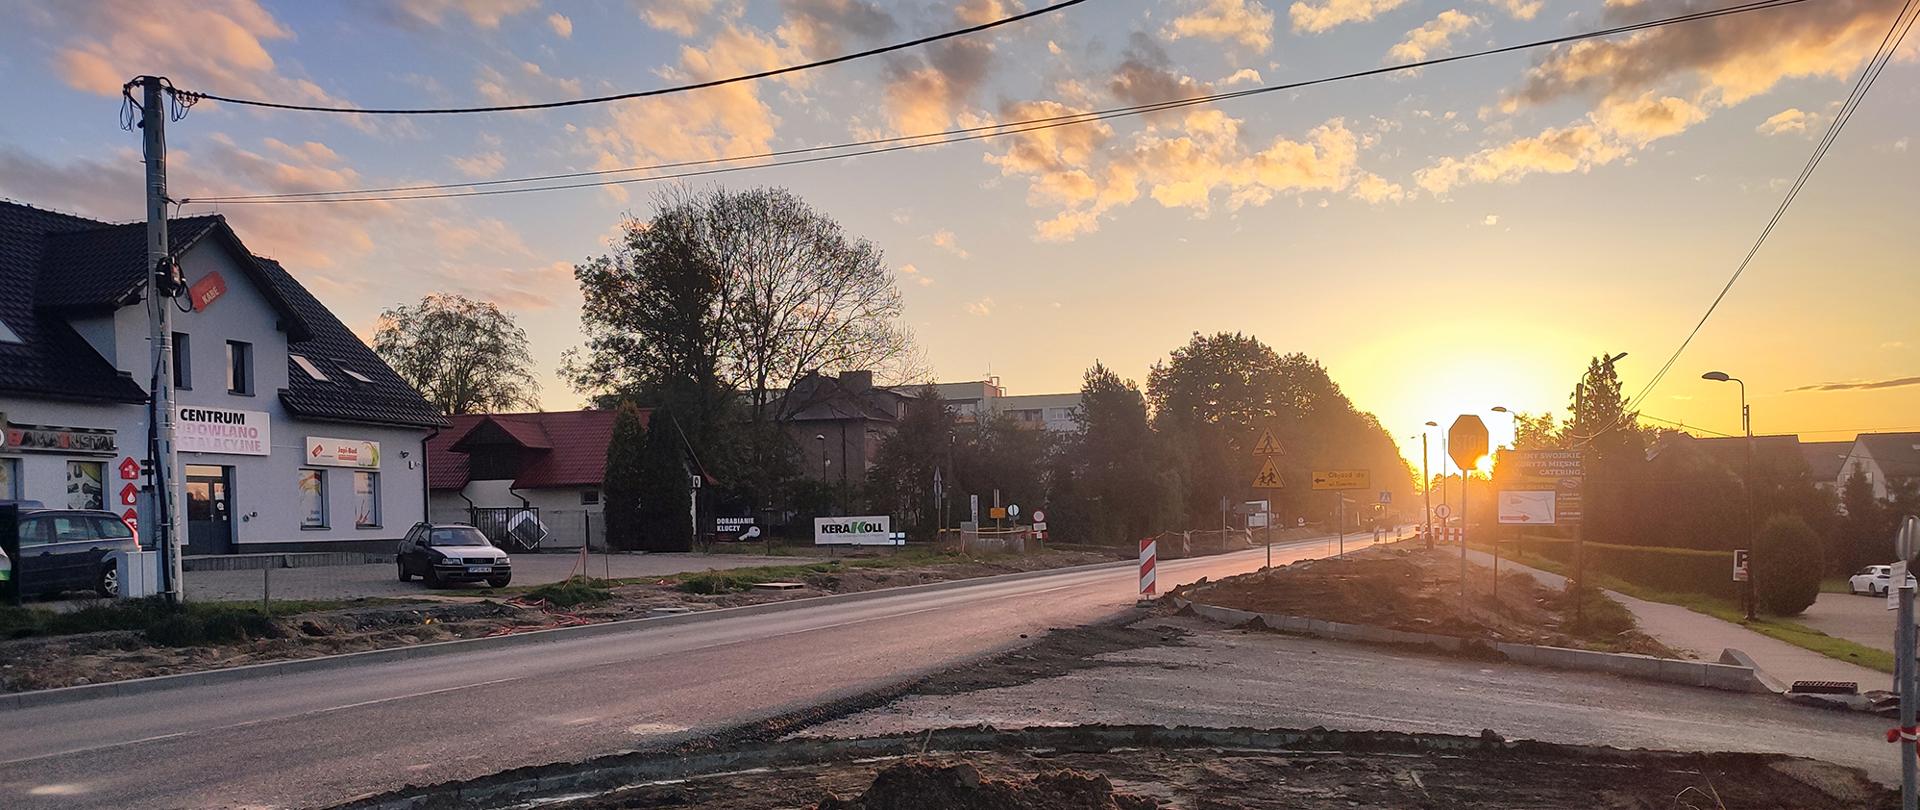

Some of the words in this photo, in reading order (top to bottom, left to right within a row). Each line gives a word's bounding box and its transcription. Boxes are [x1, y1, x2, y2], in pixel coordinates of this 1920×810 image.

[201, 286, 220, 305] KABE
[180, 408, 245, 425] CENTRUM
[716, 517, 754, 525] DORABIANIE
[821, 521, 885, 534] KERAKOLL
